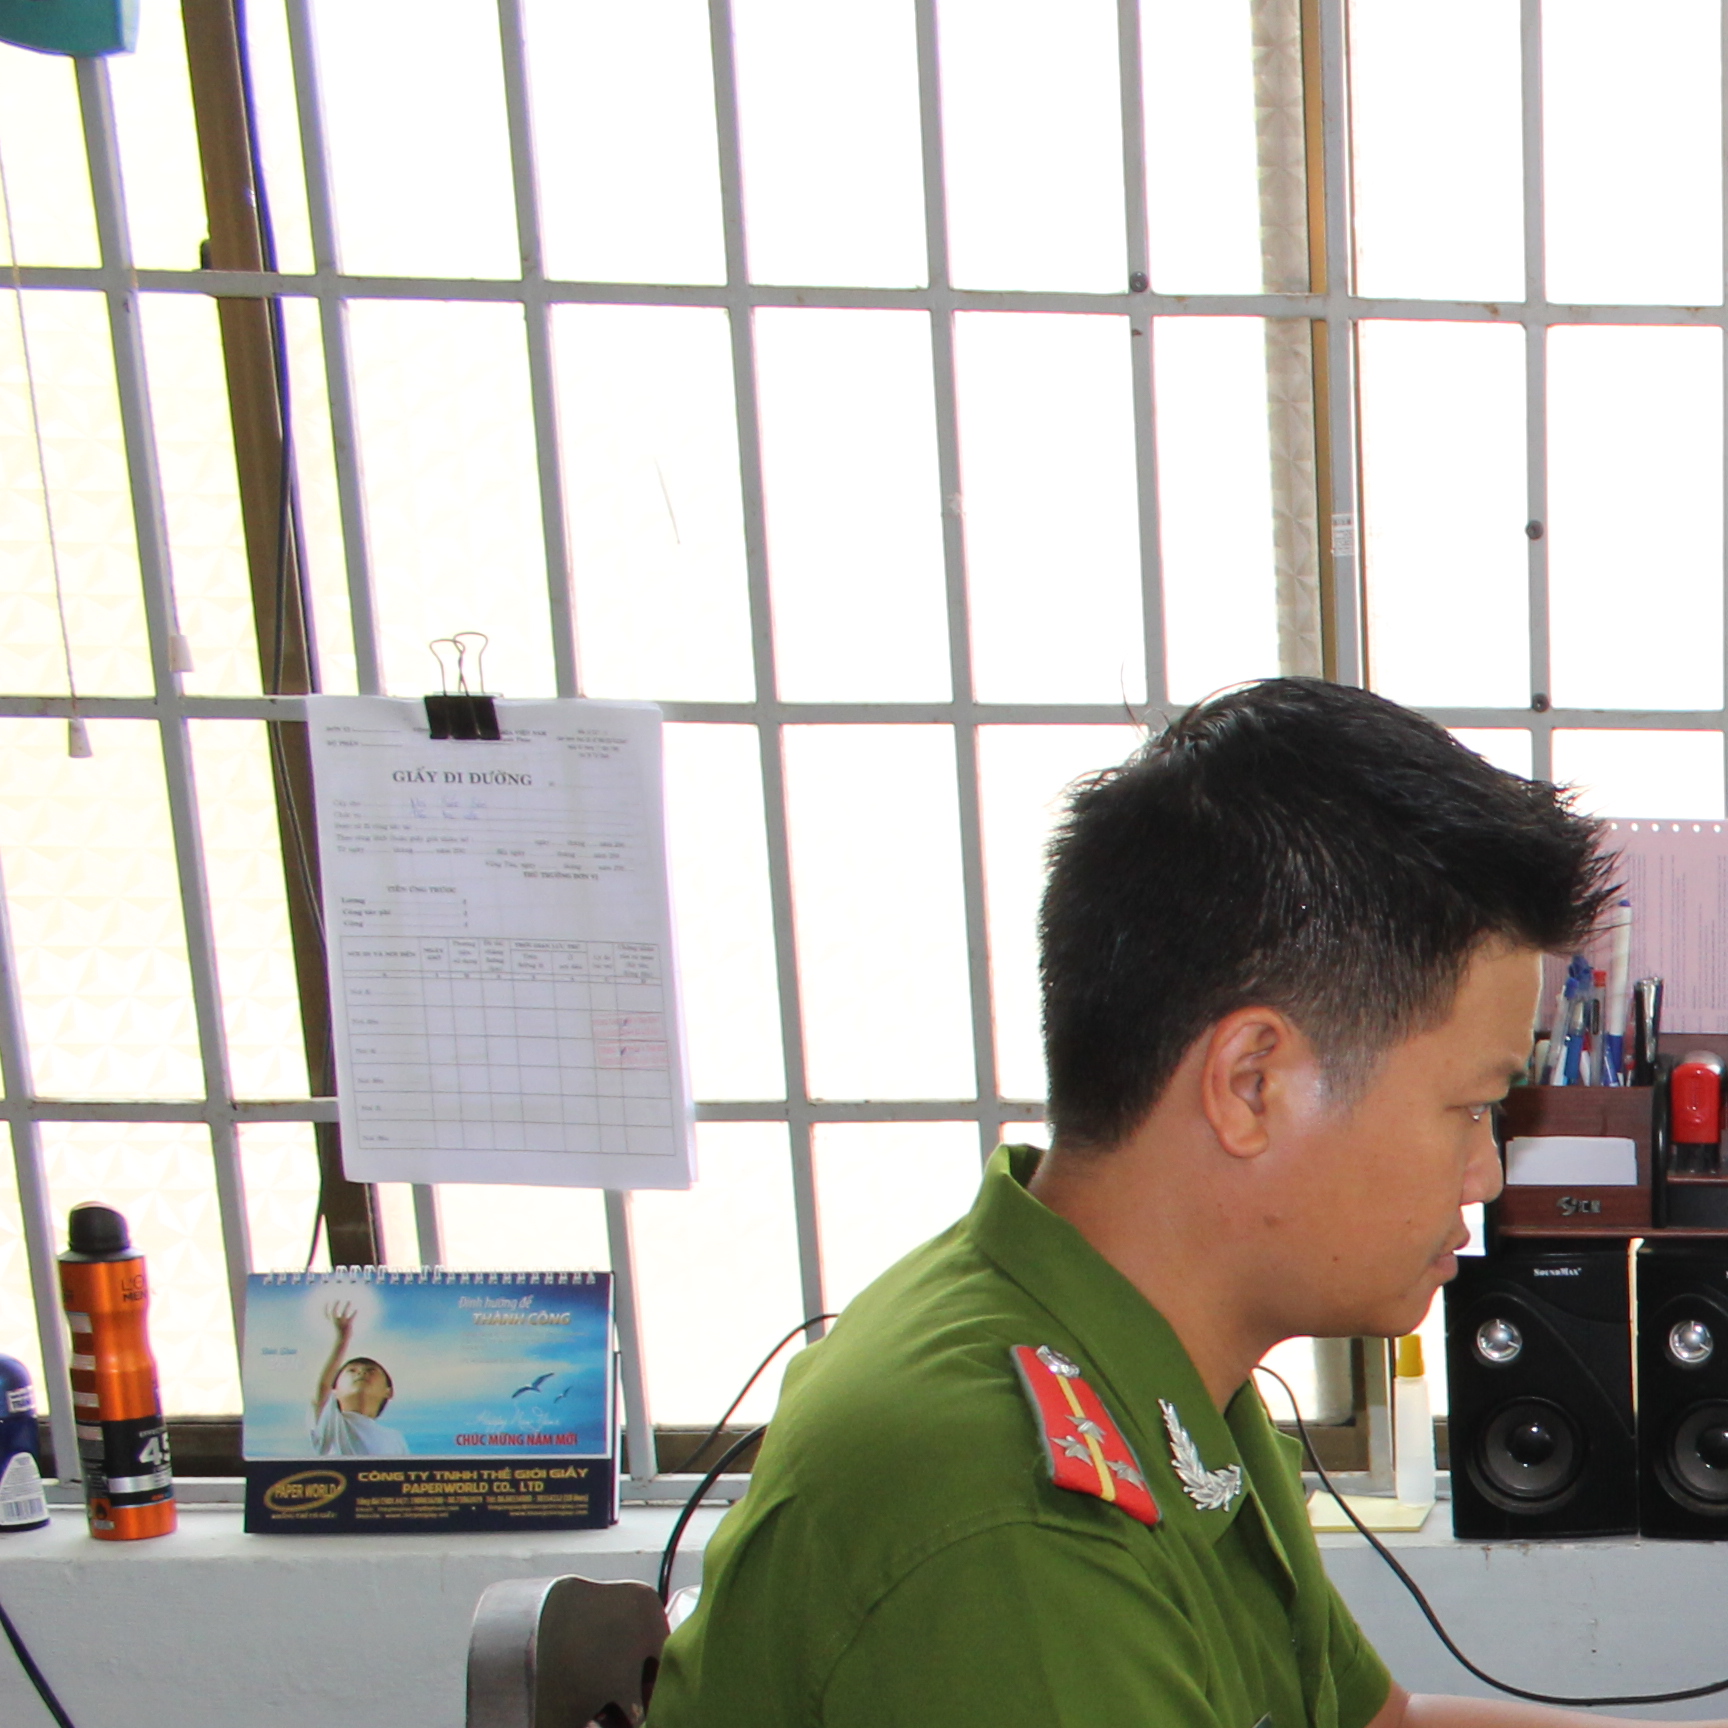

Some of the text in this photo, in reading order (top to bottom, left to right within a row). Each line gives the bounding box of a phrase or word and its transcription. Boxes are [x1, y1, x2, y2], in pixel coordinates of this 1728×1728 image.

[392, 766, 532, 787] GIẤY ĐI ĐƯỜNG
[519, 1294, 534, 1309] để
[473, 1310, 571, 1325] THÀNH CÔNG
[456, 1431, 579, 1446] CHÚC MỪNG NĂM MỚI
[357, 1465, 588, 1481] CÔNG TY TNHH THẾ GIỚI GIẤY
[275, 1483, 338, 1498] PAPER WORLD
[401, 1481, 488, 1495] PAPERWORLD
[520, 1480, 544, 1492] LTD
